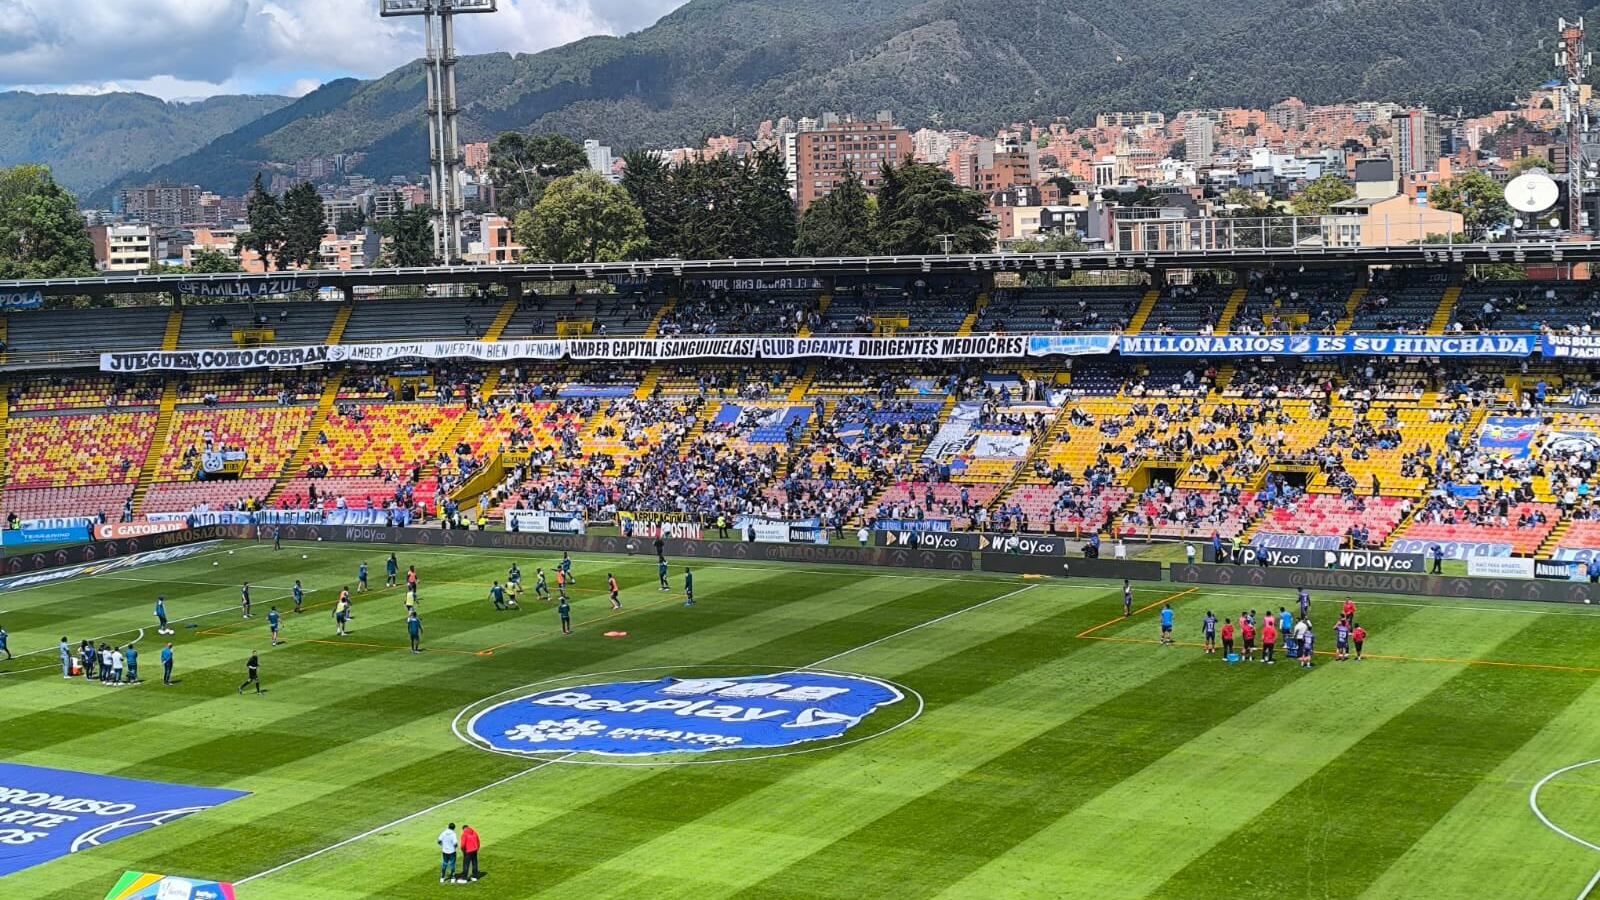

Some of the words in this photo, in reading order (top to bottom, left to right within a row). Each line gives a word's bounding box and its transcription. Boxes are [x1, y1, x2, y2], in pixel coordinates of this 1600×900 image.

[351, 345, 382, 359] AMBER
[487, 344, 508, 358] BIEN
[570, 341, 610, 357] AMBER
[612, 341, 657, 357] CAPITAL
[762, 339, 794, 355] CLUB
[858, 339, 938, 356] DIRIGENTES
[941, 337, 1023, 355] MEDIOCRES
[1123, 337, 1285, 353] MILLONARIOS
[1316, 337, 1346, 351] ES
[1353, 337, 1389, 351] SU
[1392, 337, 1529, 353] HINCHADA
[201, 351, 254, 368] COMO
[153, 525, 237, 547] @MAOSAZON
[1340, 552, 1411, 571] Wplay.co
[1536, 562, 1569, 577] ANDINA
[1288, 573, 1421, 593] @MAOSAZON
